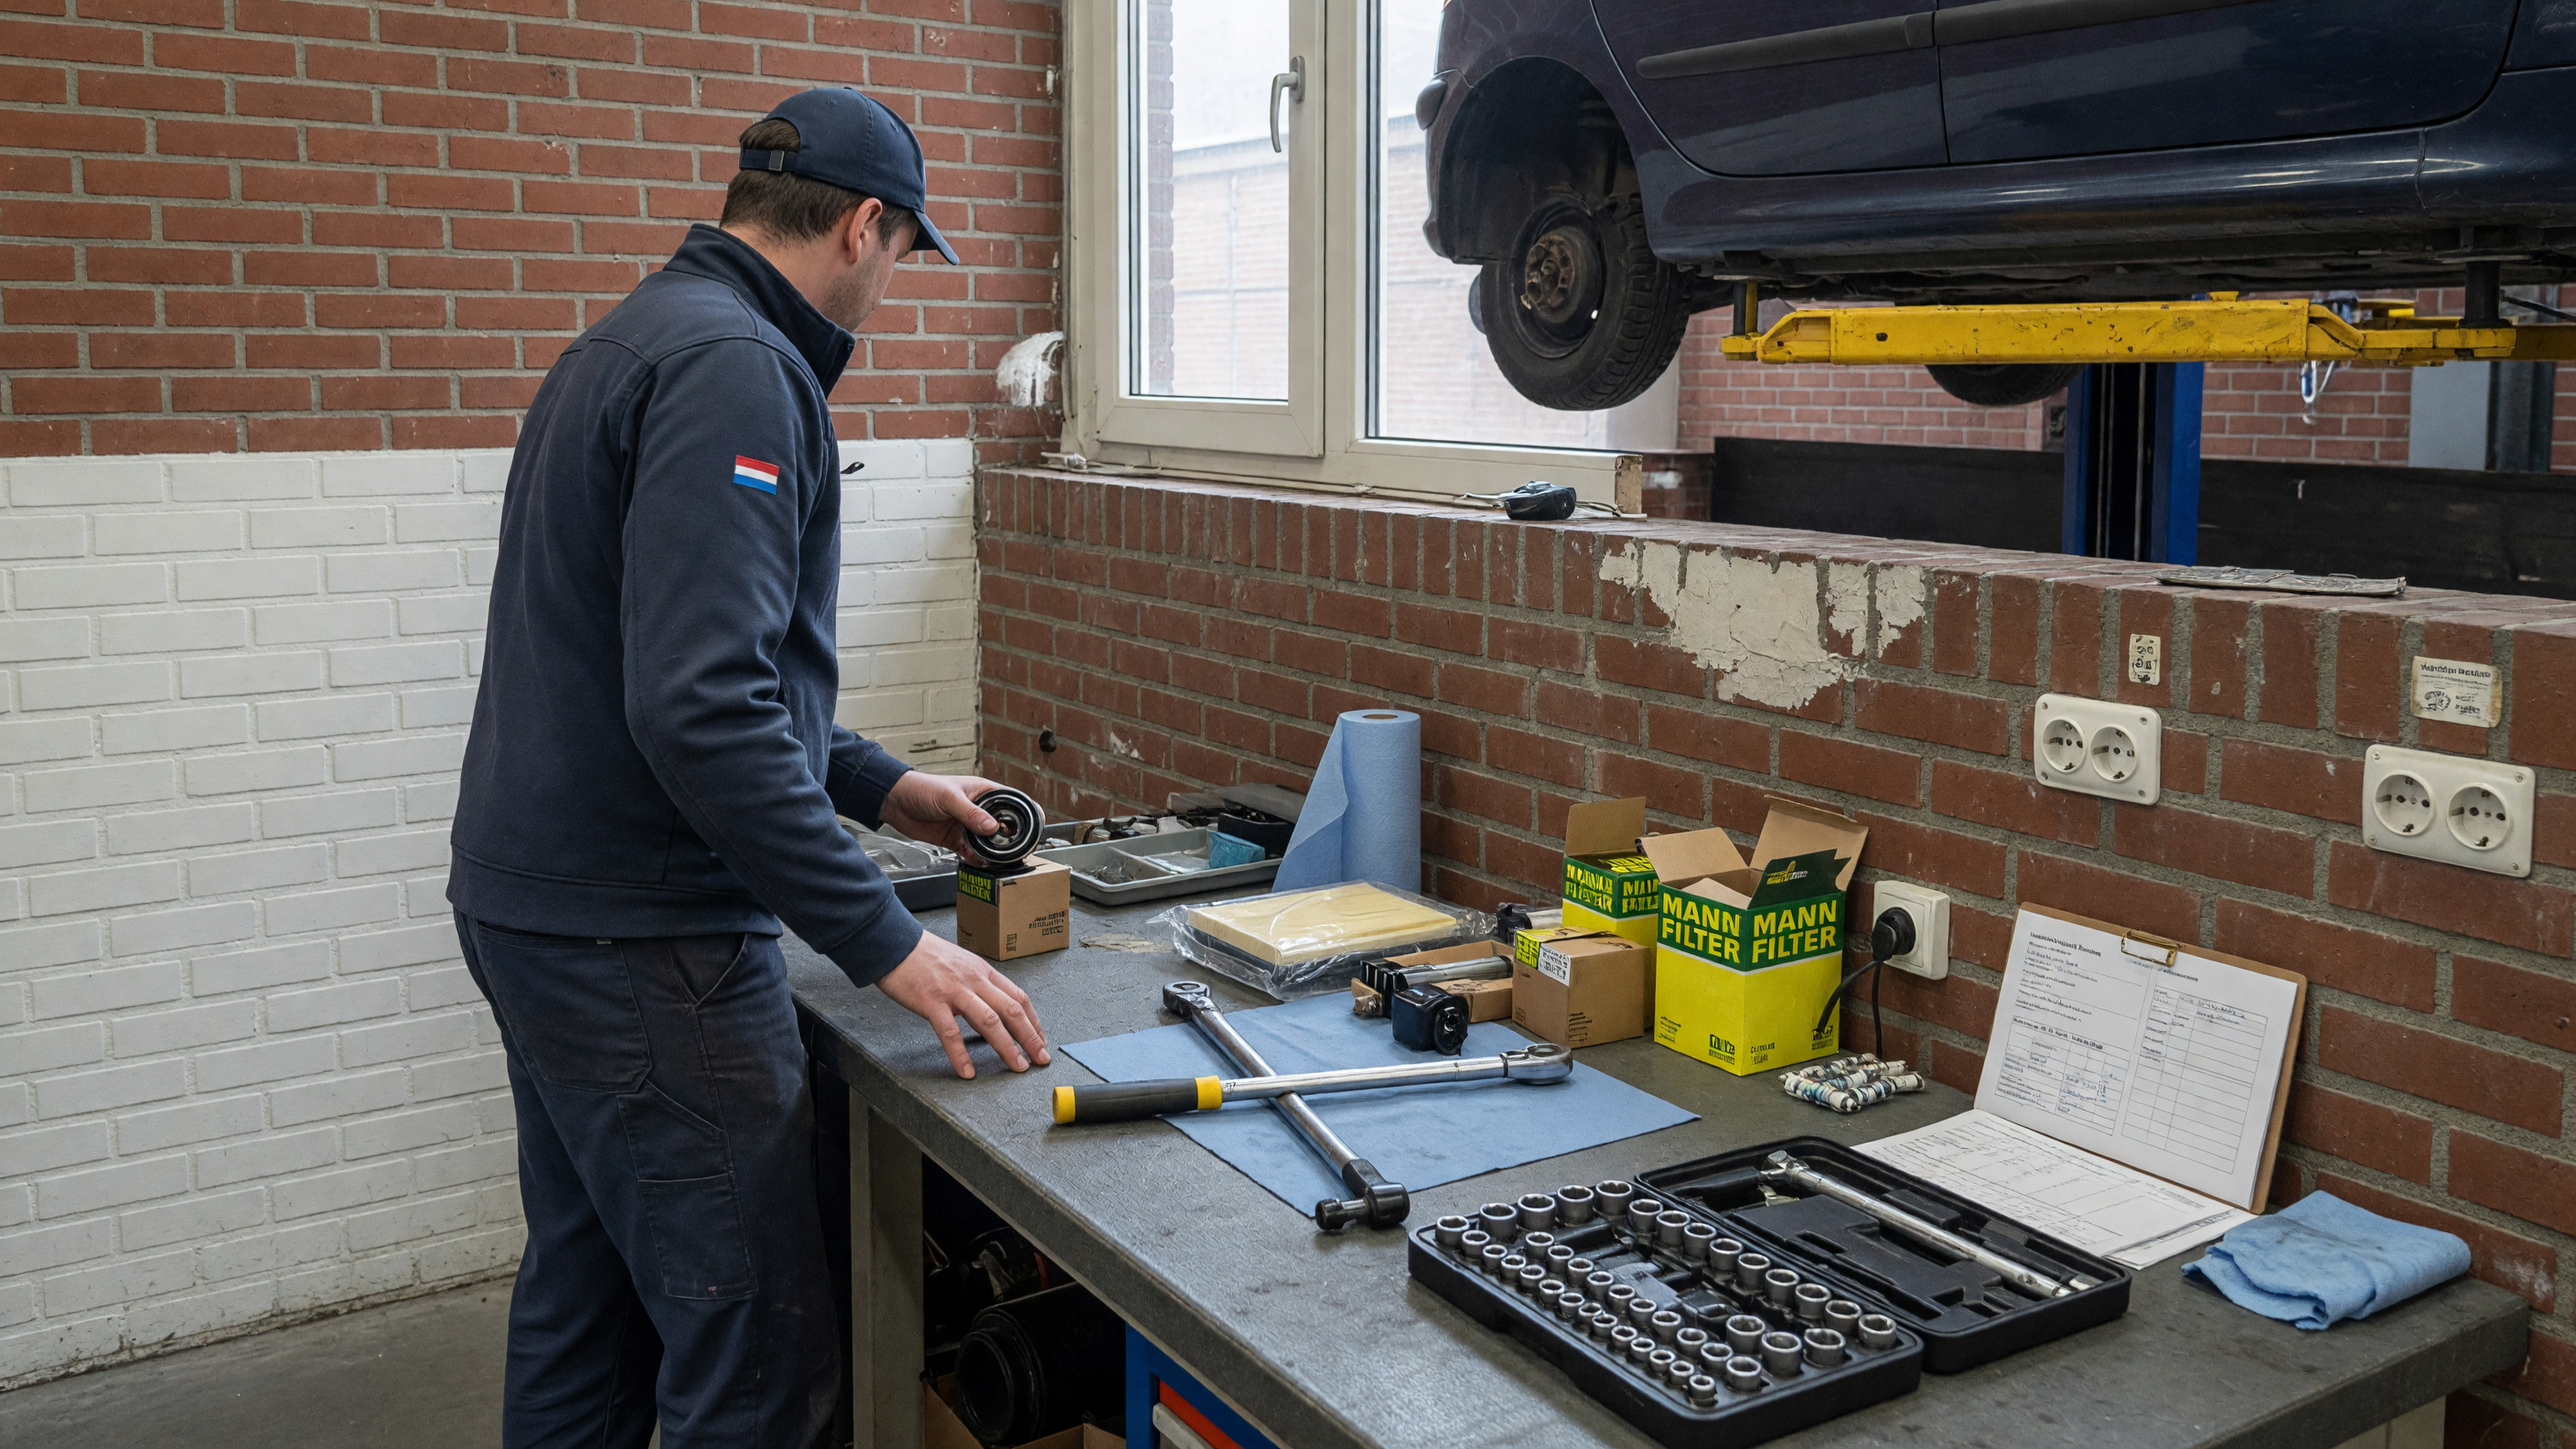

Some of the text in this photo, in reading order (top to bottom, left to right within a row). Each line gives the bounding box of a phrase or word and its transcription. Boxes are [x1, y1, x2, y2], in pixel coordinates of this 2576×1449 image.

[1662, 893, 1740, 938] MANN
[1754, 900, 1837, 938] MANN
[1662, 918, 1740, 963] FILTER
[1752, 926, 1836, 963] FILTER
